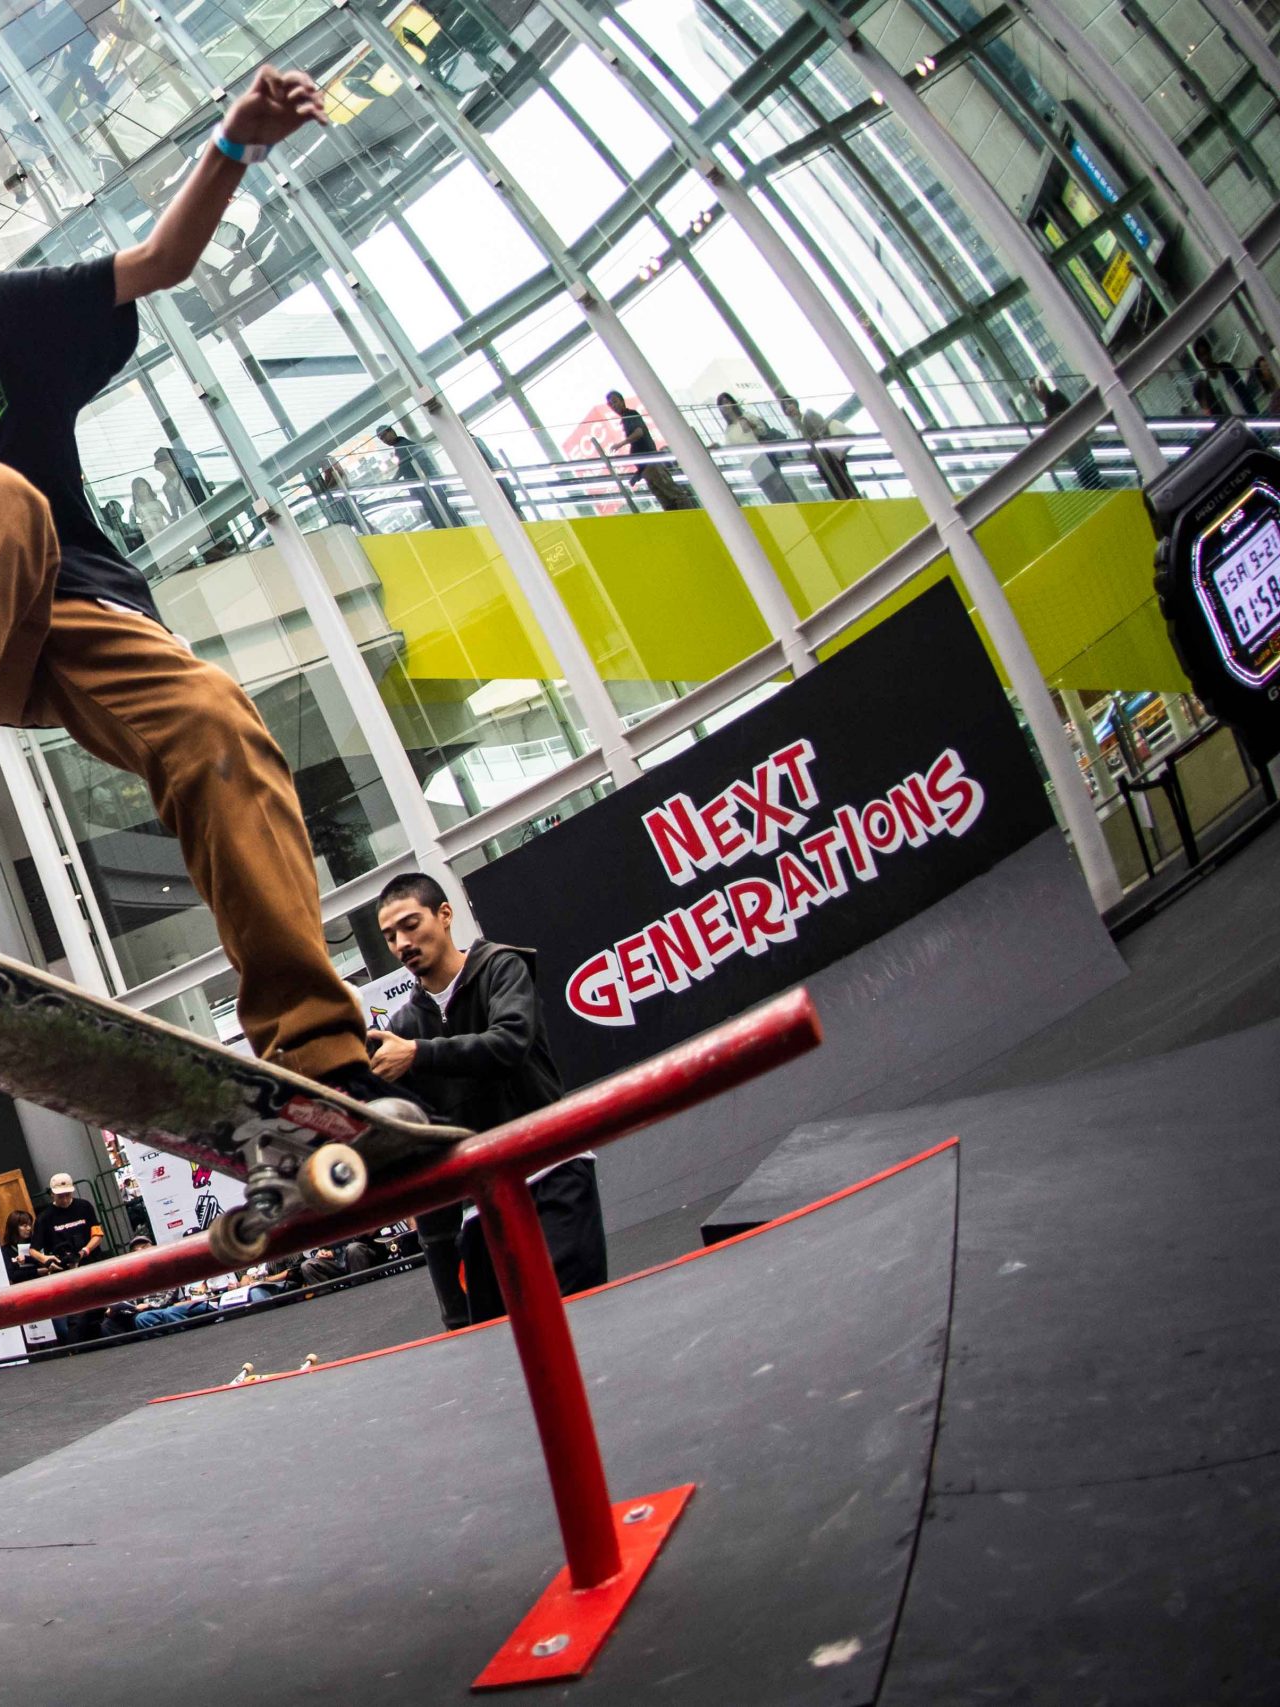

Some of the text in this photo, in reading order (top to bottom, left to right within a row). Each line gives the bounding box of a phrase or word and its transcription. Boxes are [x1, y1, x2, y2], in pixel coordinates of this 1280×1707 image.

[1195, 468, 1252, 522] PROTECTION
[641, 739, 820, 886] NEXT
[566, 747, 985, 1026] GENERATIONS
